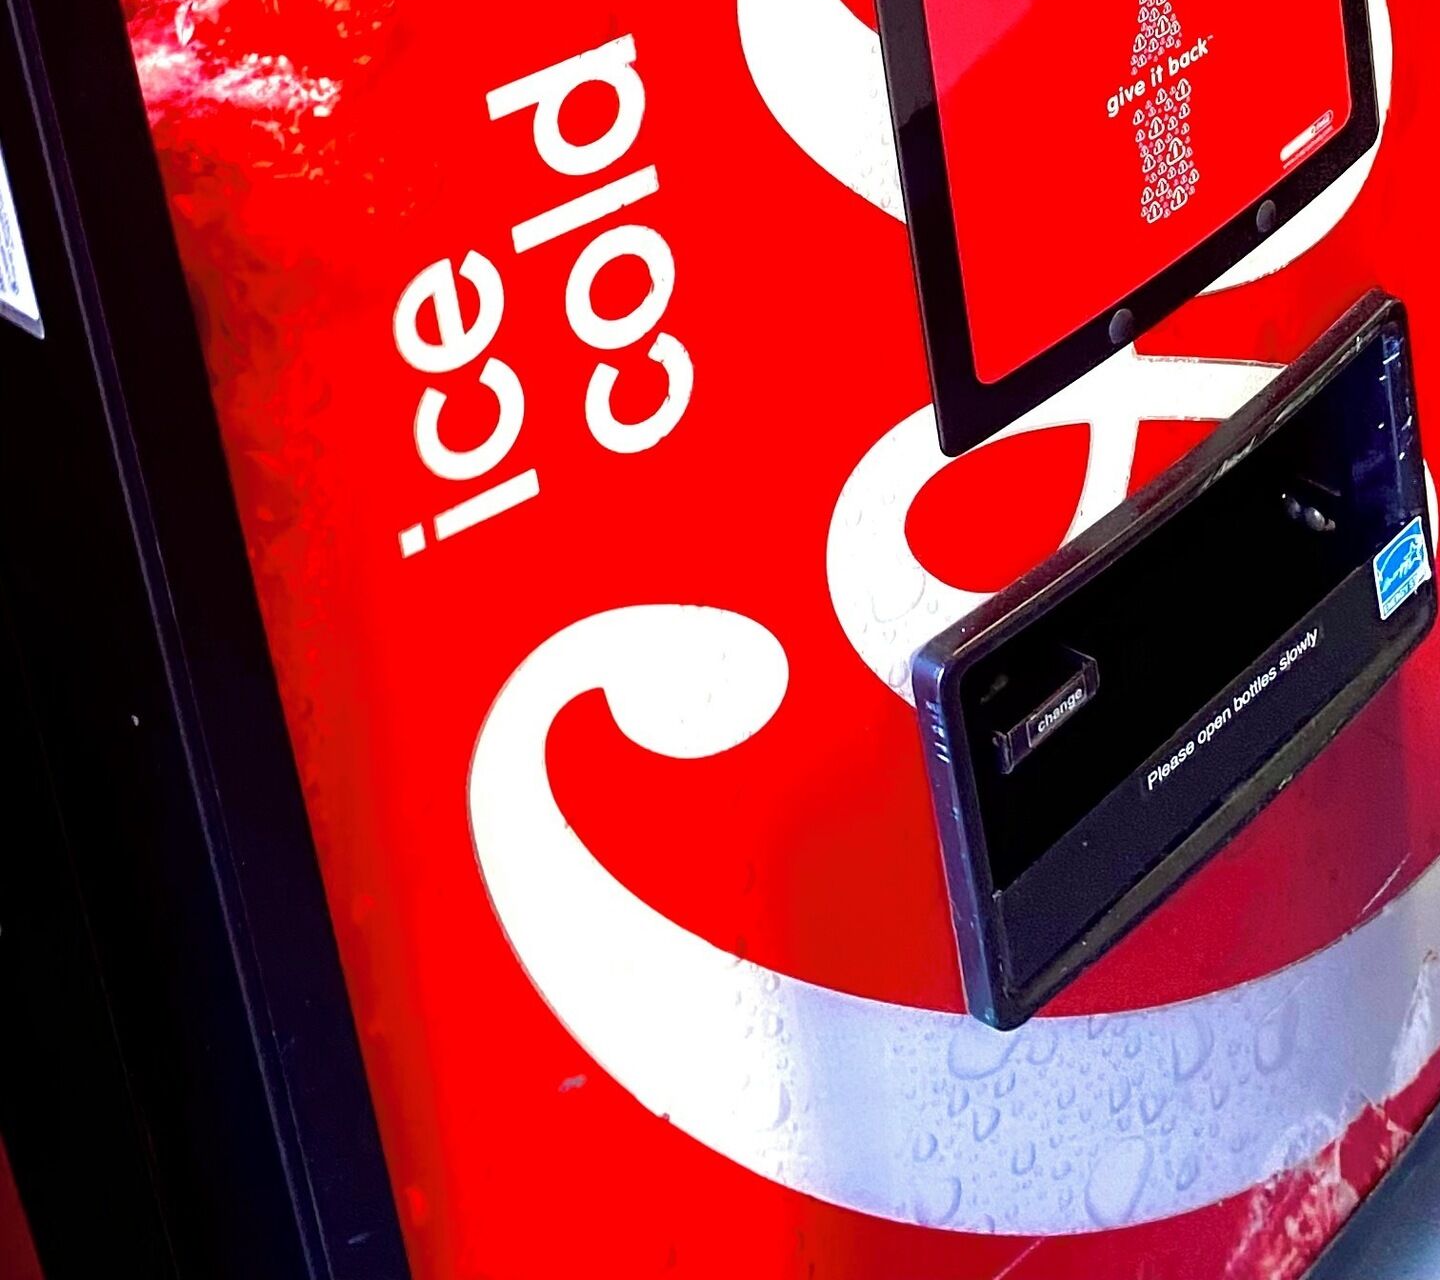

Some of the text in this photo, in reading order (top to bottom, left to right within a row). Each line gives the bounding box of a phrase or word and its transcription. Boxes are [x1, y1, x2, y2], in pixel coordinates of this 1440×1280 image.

[1106, 37, 1209, 119] give it back
[485, 33, 695, 455] cold
[392, 249, 541, 559] ice
[1037, 687, 1083, 733] change
[1147, 628, 1319, 791] Please open bottles slowly
